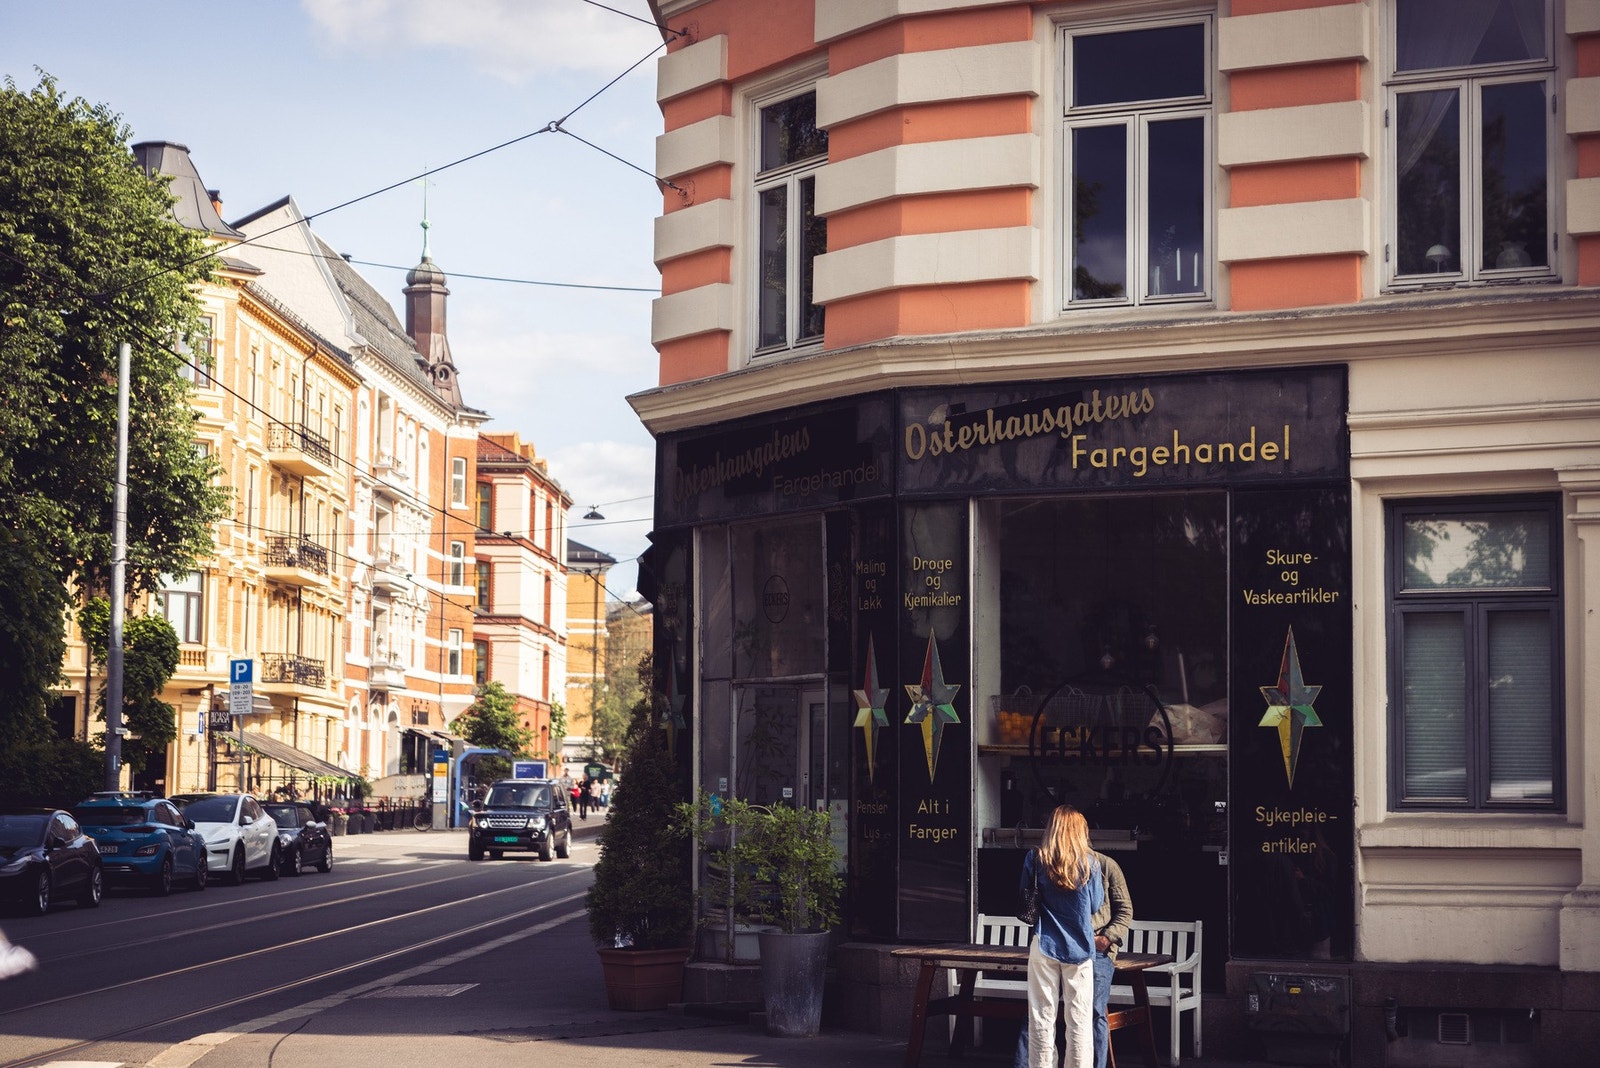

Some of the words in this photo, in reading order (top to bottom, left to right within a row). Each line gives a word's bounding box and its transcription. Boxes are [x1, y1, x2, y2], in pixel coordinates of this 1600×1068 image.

[905, 387, 1155, 461] Osterhausgatens
[1072, 425, 1291, 478] Fargehandel
[671, 425, 811, 503] Osterhausgatens
[773, 459, 880, 497] Fargehandel
[913, 557, 953, 573] Droge
[1266, 550, 1319, 566] Skure-
[855, 559, 886, 577] Maling
[865, 578, 877, 593] og
[926, 574, 942, 590] og
[1281, 569, 1299, 587] og
[858, 595, 883, 611] Lakk
[904, 592, 961, 610] Kjemikalier
[1243, 589, 1339, 606] Vaskeartikler
[235, 662, 248, 681] P
[1040, 726, 1163, 766] ECKERS
[856, 799, 888, 814] Pensler
[917, 799, 939, 815] Alt
[945, 799, 950, 814] i
[1256, 806, 1338, 827] Sykepleie-
[863, 823, 880, 843] Lys
[909, 823, 958, 843] Farger
[1261, 837, 1317, 855] artikler
